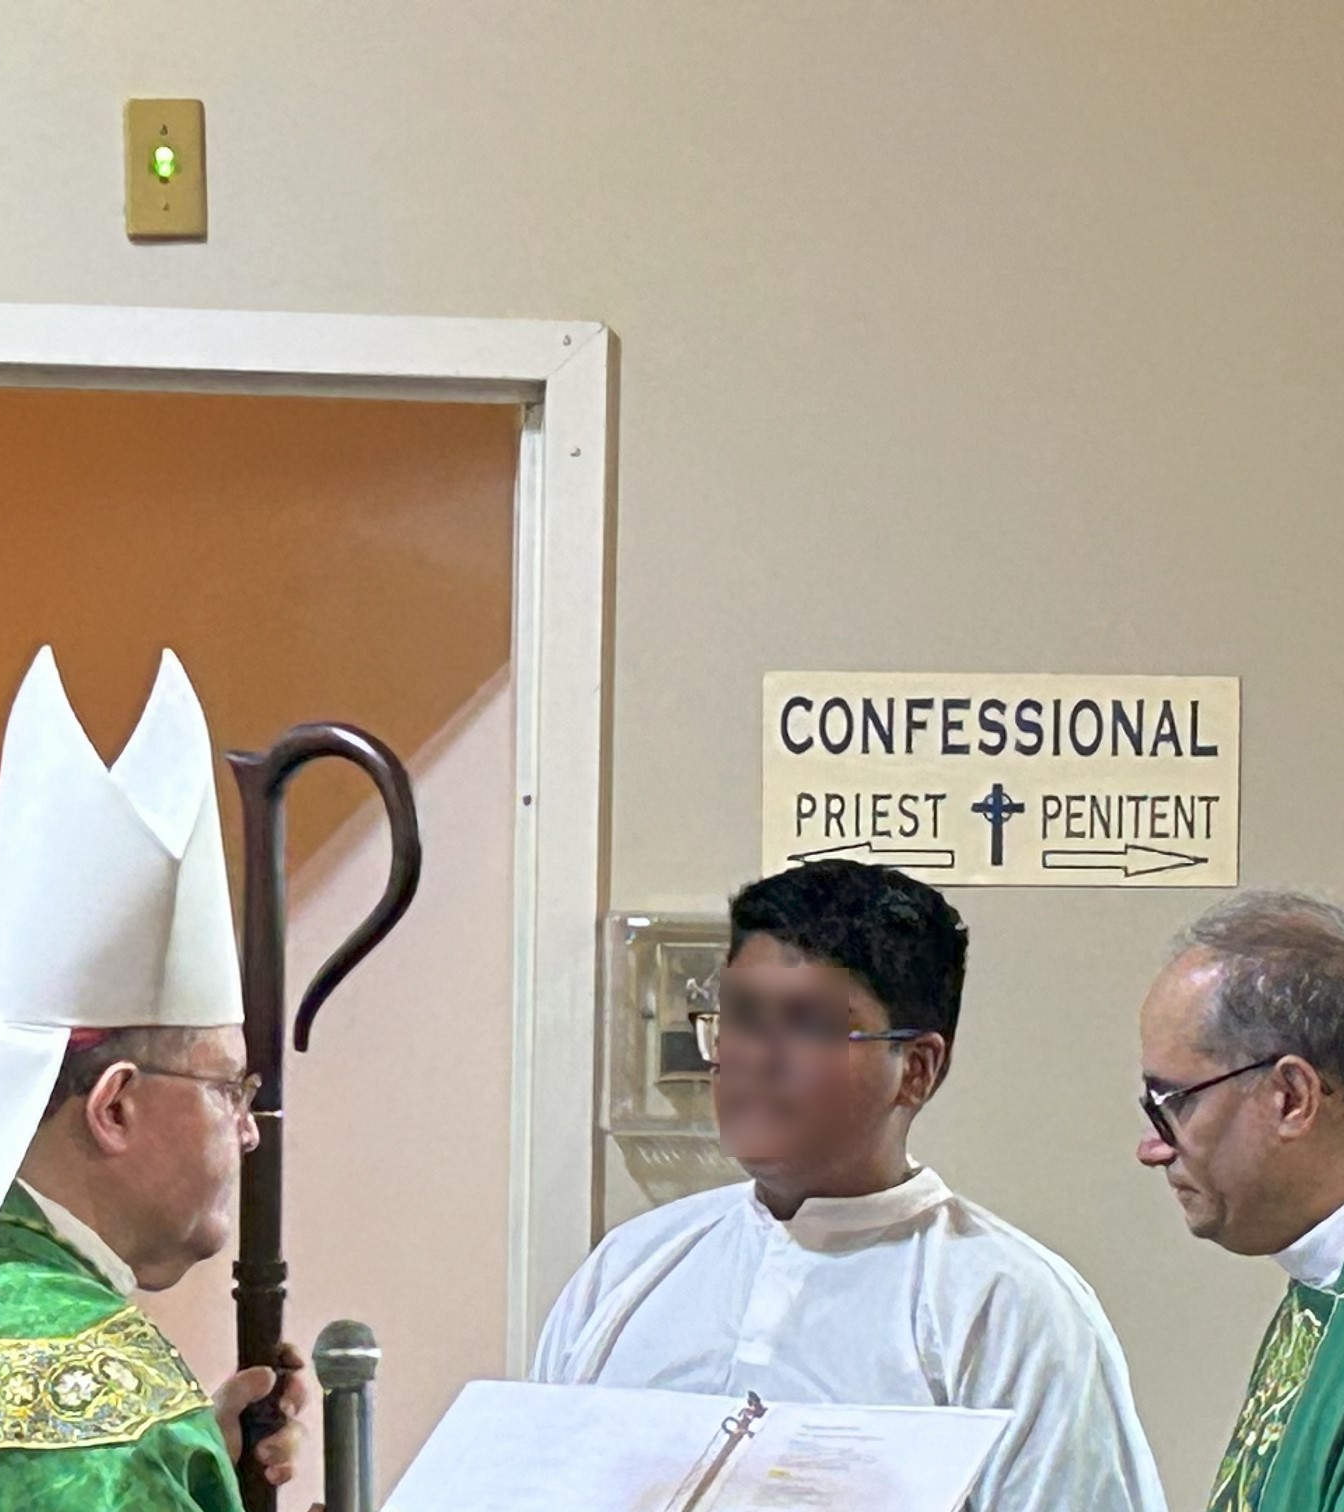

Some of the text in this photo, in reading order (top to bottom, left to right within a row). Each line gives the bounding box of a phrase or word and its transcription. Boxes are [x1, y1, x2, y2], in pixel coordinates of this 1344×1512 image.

[780, 697, 1218, 756] CONFESSIONAL
[796, 792, 1219, 839] PRIEST PENITENT
